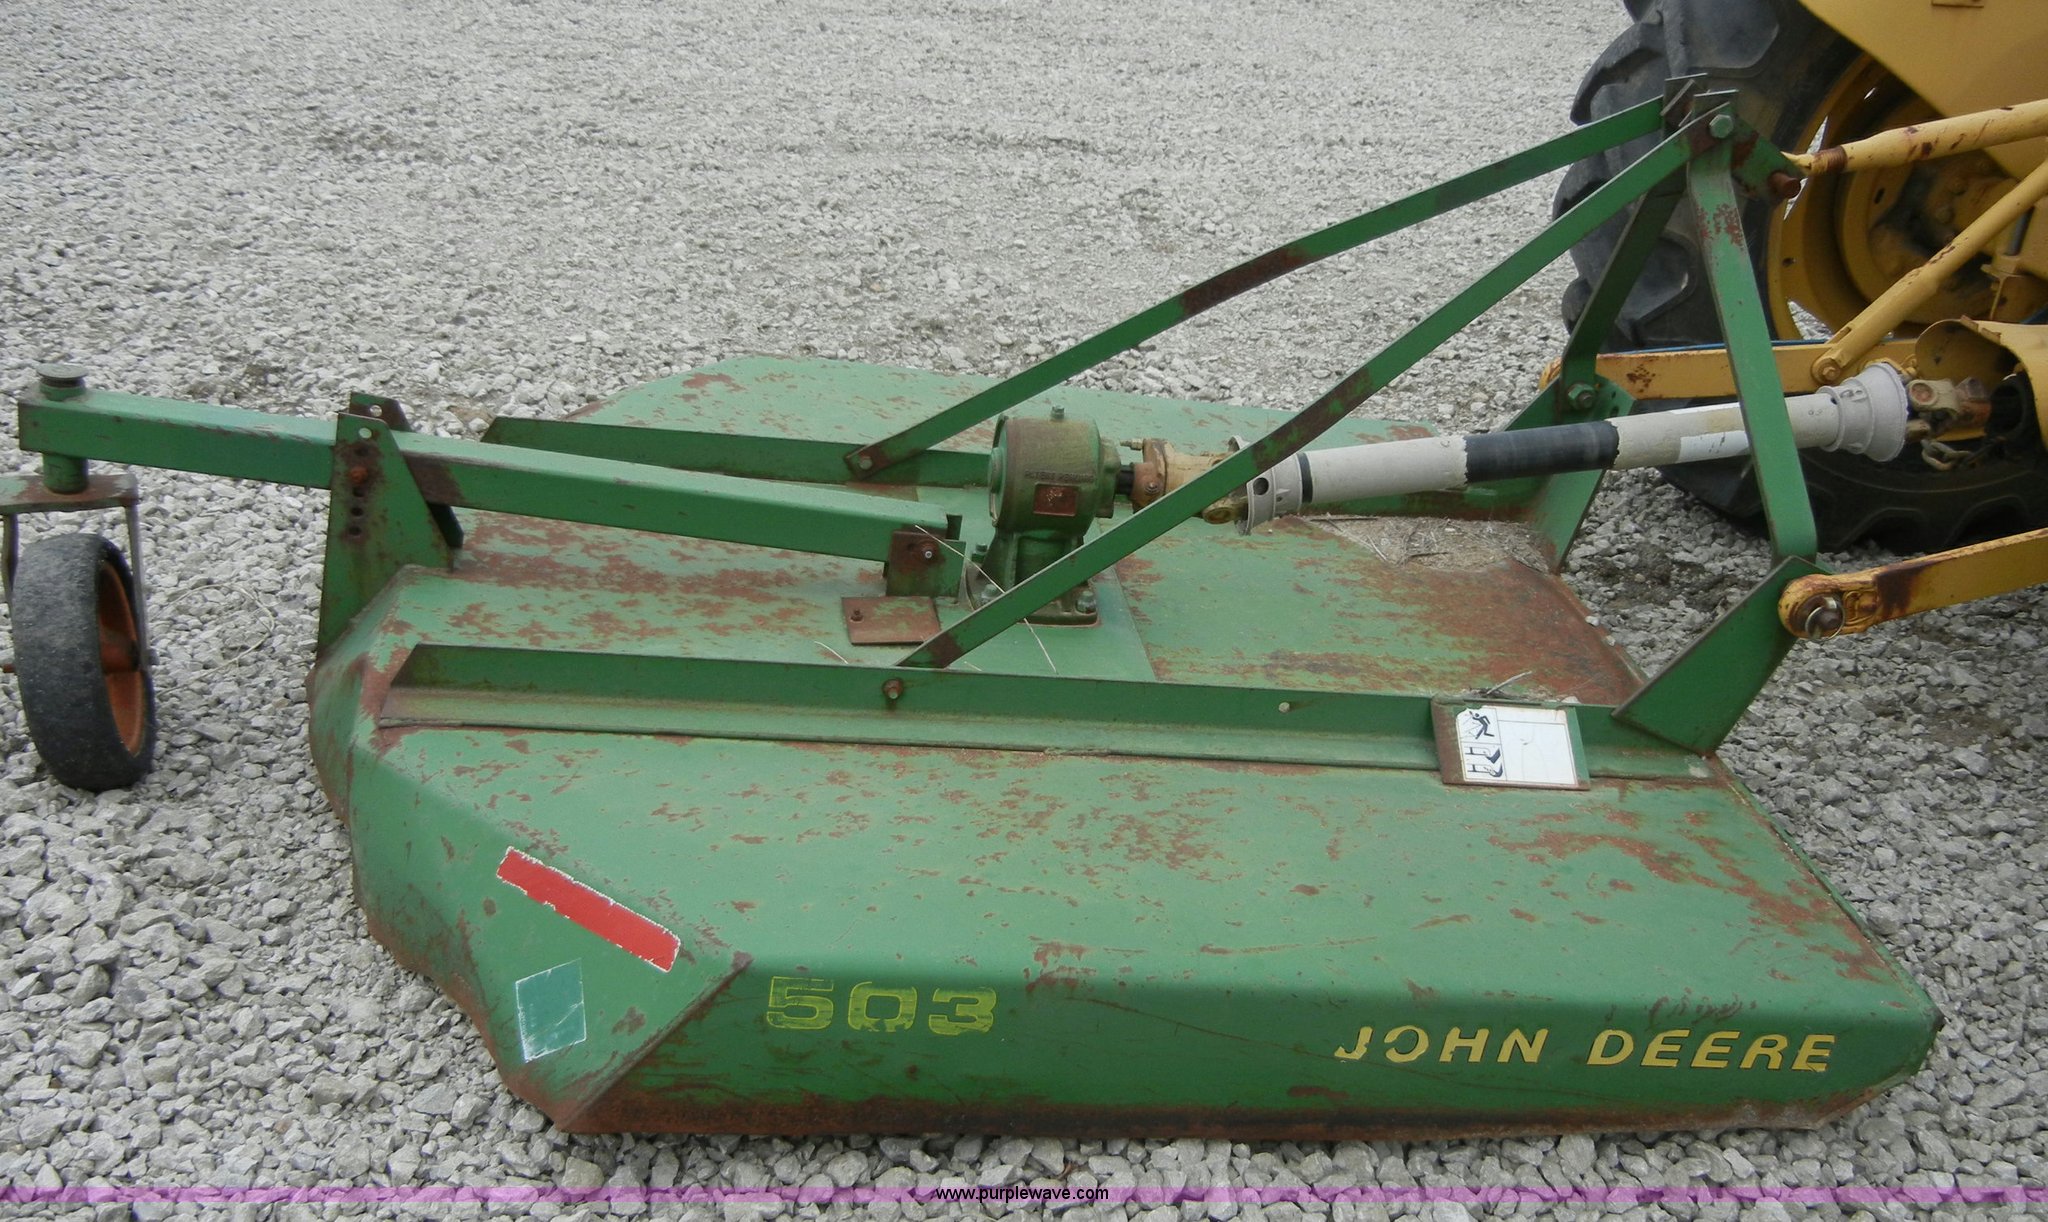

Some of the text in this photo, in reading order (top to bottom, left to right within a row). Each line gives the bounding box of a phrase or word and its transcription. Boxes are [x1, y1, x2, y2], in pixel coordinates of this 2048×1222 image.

[767, 976, 997, 1035] 503
[1334, 1025, 1836, 1072] JOHN DEERE
